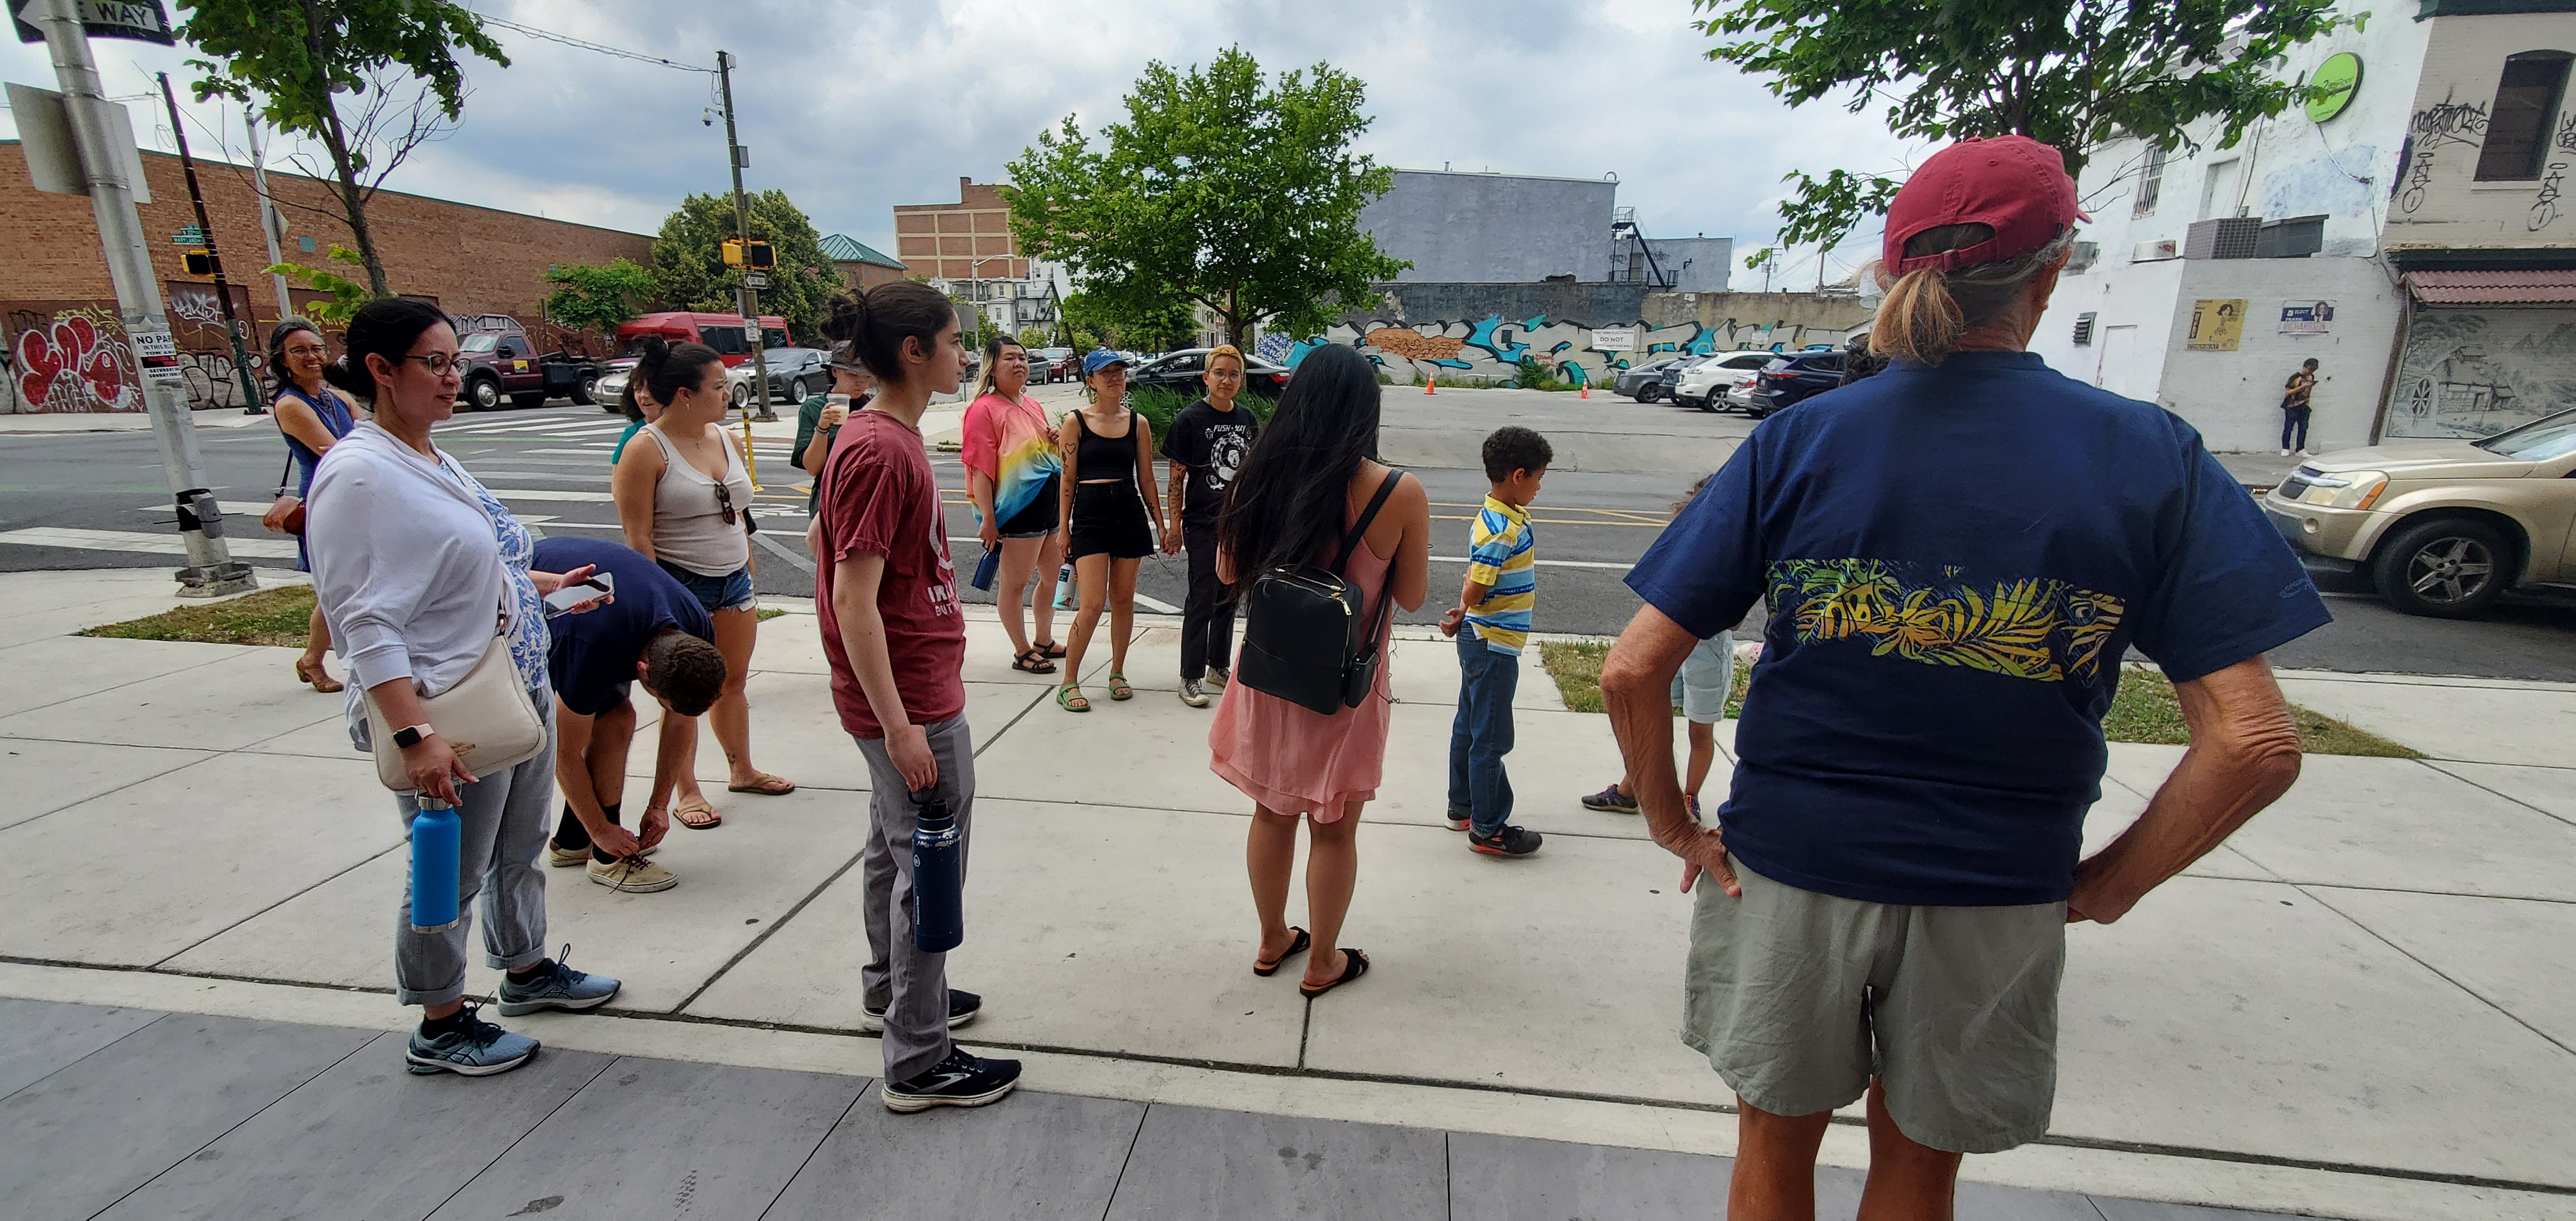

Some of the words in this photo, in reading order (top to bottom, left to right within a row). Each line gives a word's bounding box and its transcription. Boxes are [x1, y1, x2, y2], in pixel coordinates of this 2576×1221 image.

[96, 3, 147, 26] WAY
[2283, 322, 2326, 331] RICHARDSON
[136, 336, 153, 344] NO
